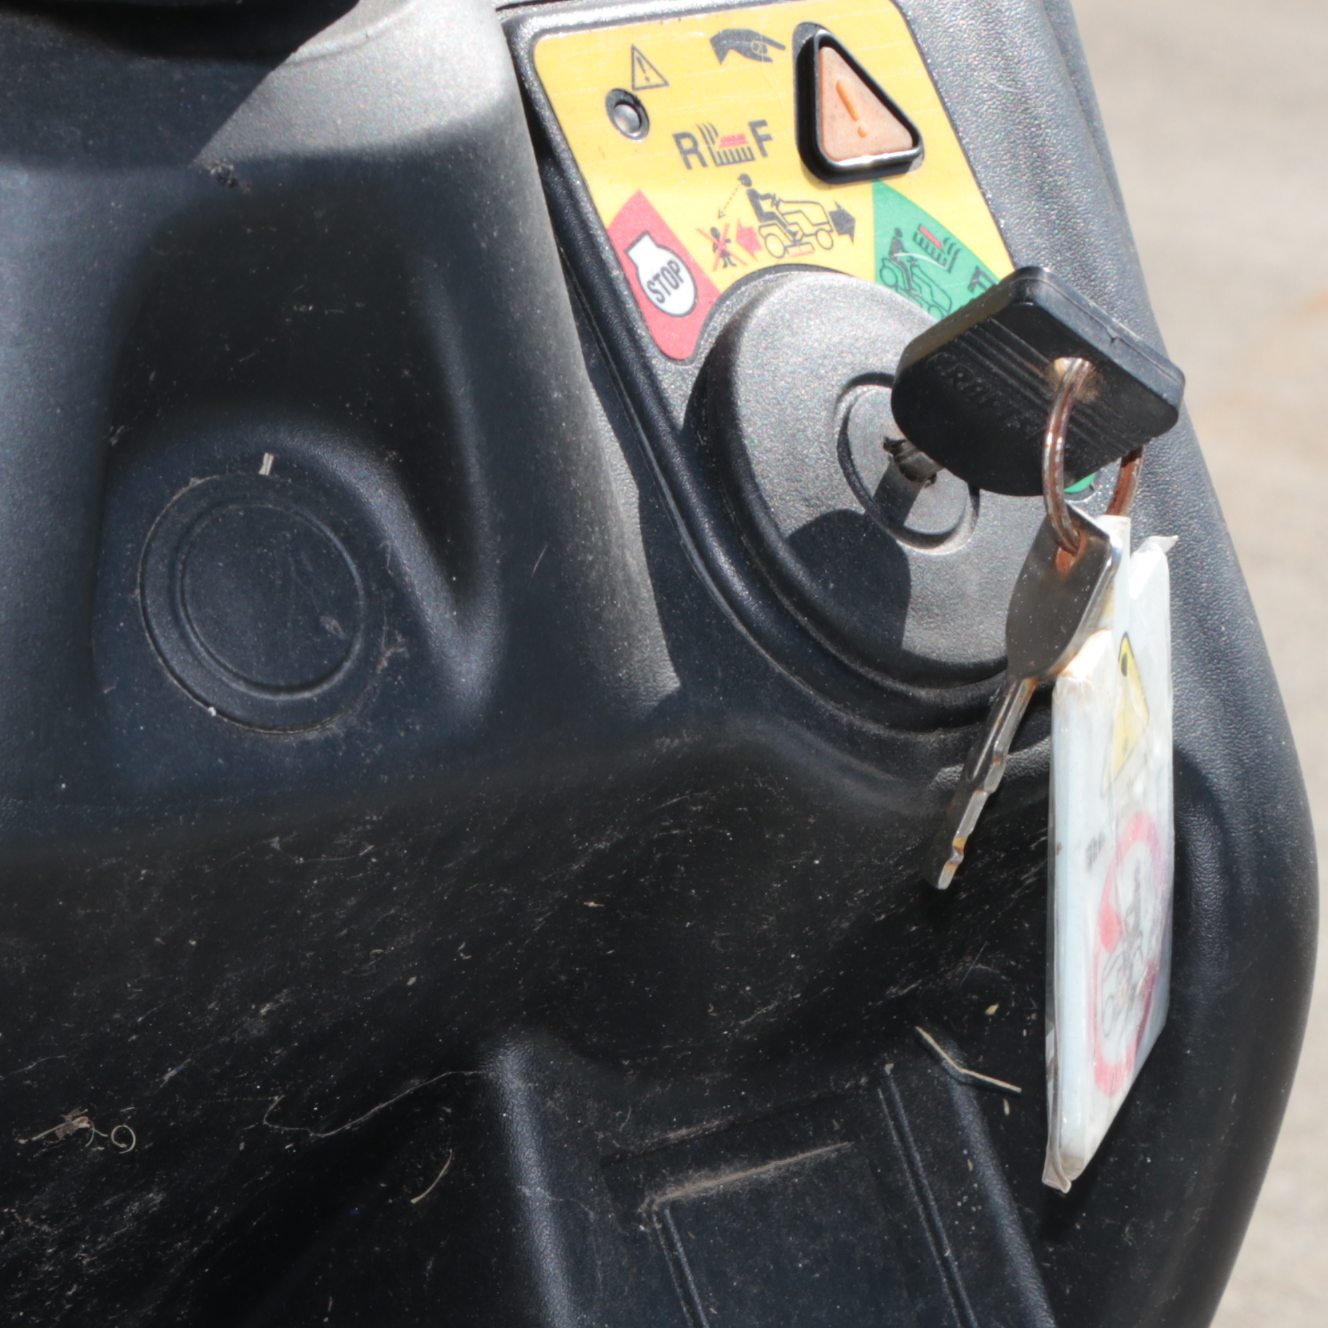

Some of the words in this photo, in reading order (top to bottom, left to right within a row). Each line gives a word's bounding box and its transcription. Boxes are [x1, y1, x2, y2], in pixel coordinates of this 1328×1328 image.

[672, 131, 708, 170] R
[748, 119, 773, 158] F
[646, 259, 684, 304] STOP
